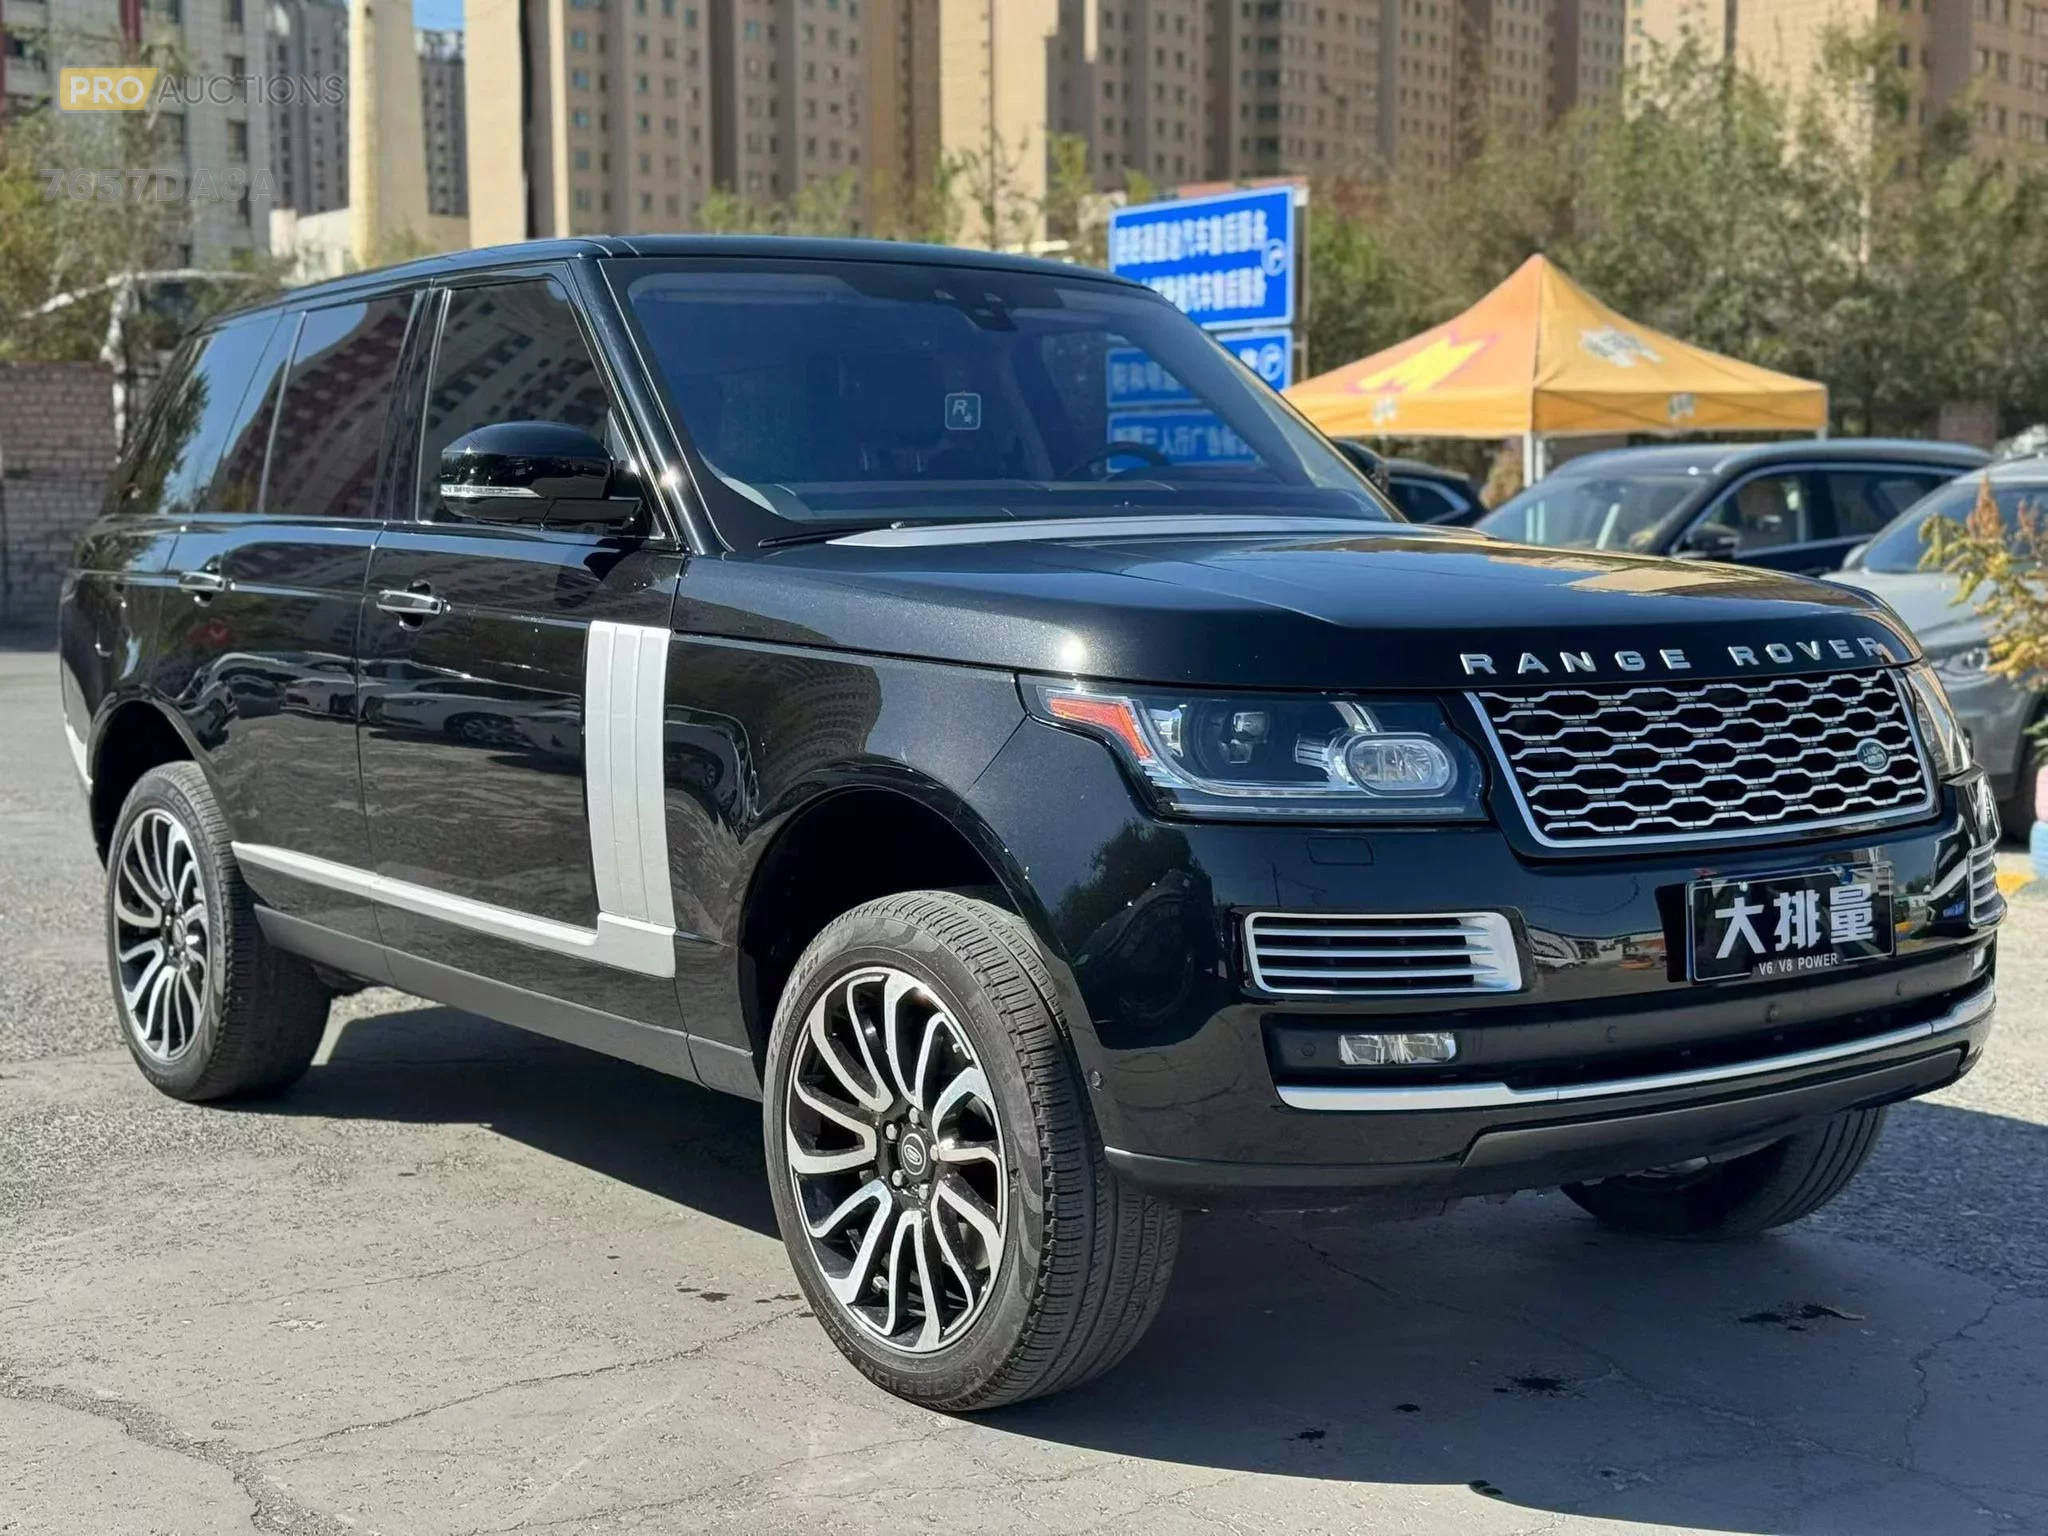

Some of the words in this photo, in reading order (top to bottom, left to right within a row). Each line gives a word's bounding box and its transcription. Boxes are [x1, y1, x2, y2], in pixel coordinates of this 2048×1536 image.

[1459, 648, 1692, 675] RANGE
[1727, 636, 1886, 667] ROVER
[1714, 883, 1875, 960] 大排量
[1797, 952, 1839, 970] POWER
